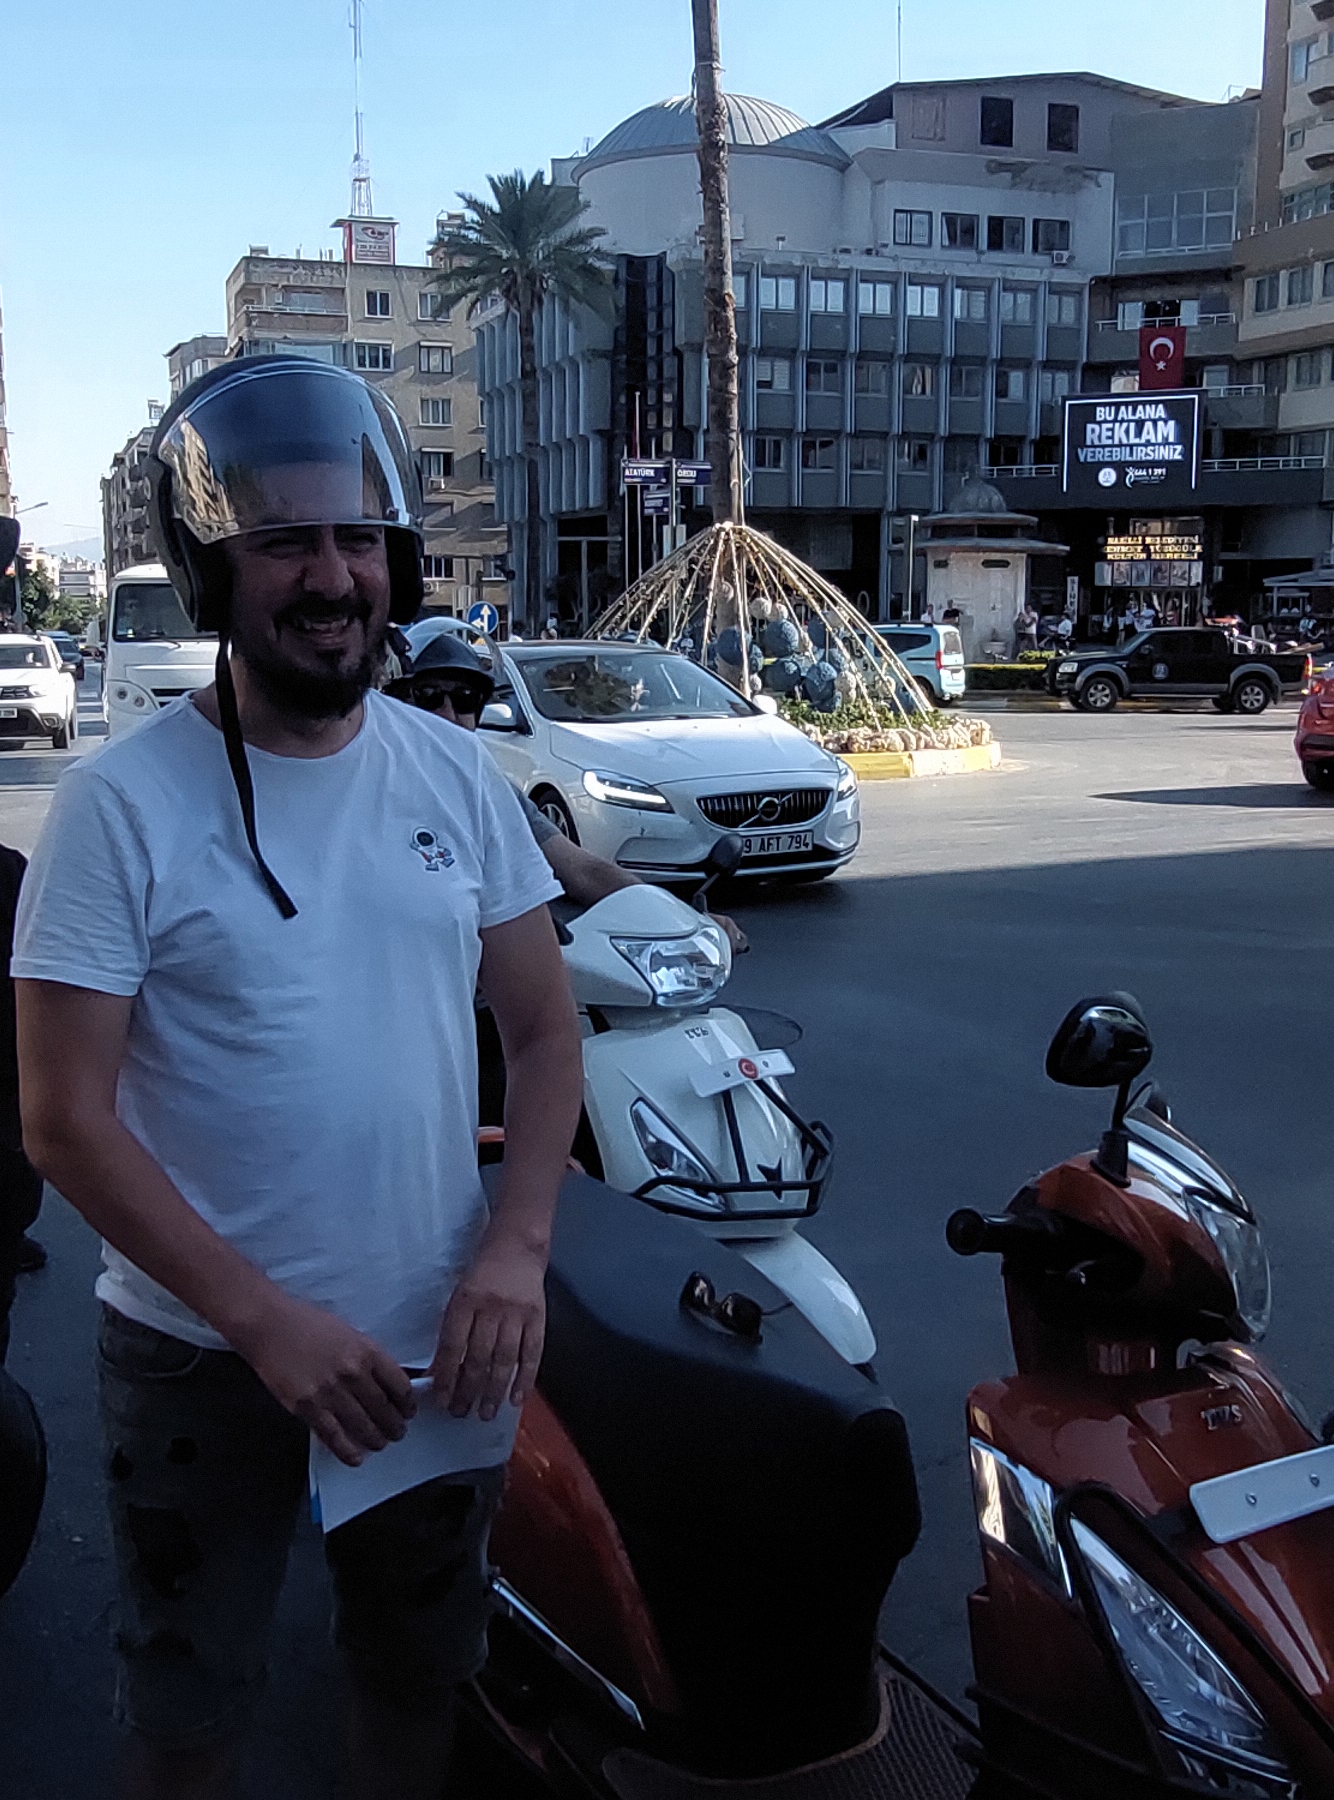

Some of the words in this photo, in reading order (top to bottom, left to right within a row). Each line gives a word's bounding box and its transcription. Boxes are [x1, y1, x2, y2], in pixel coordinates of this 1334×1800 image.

[1096, 406, 1116, 421] BU
[1118, 404, 1166, 420] ALANA
[1085, 420, 1176, 445] REKLAM
[759, 836, 781, 853] AFT
[786, 834, 809, 851] 794
